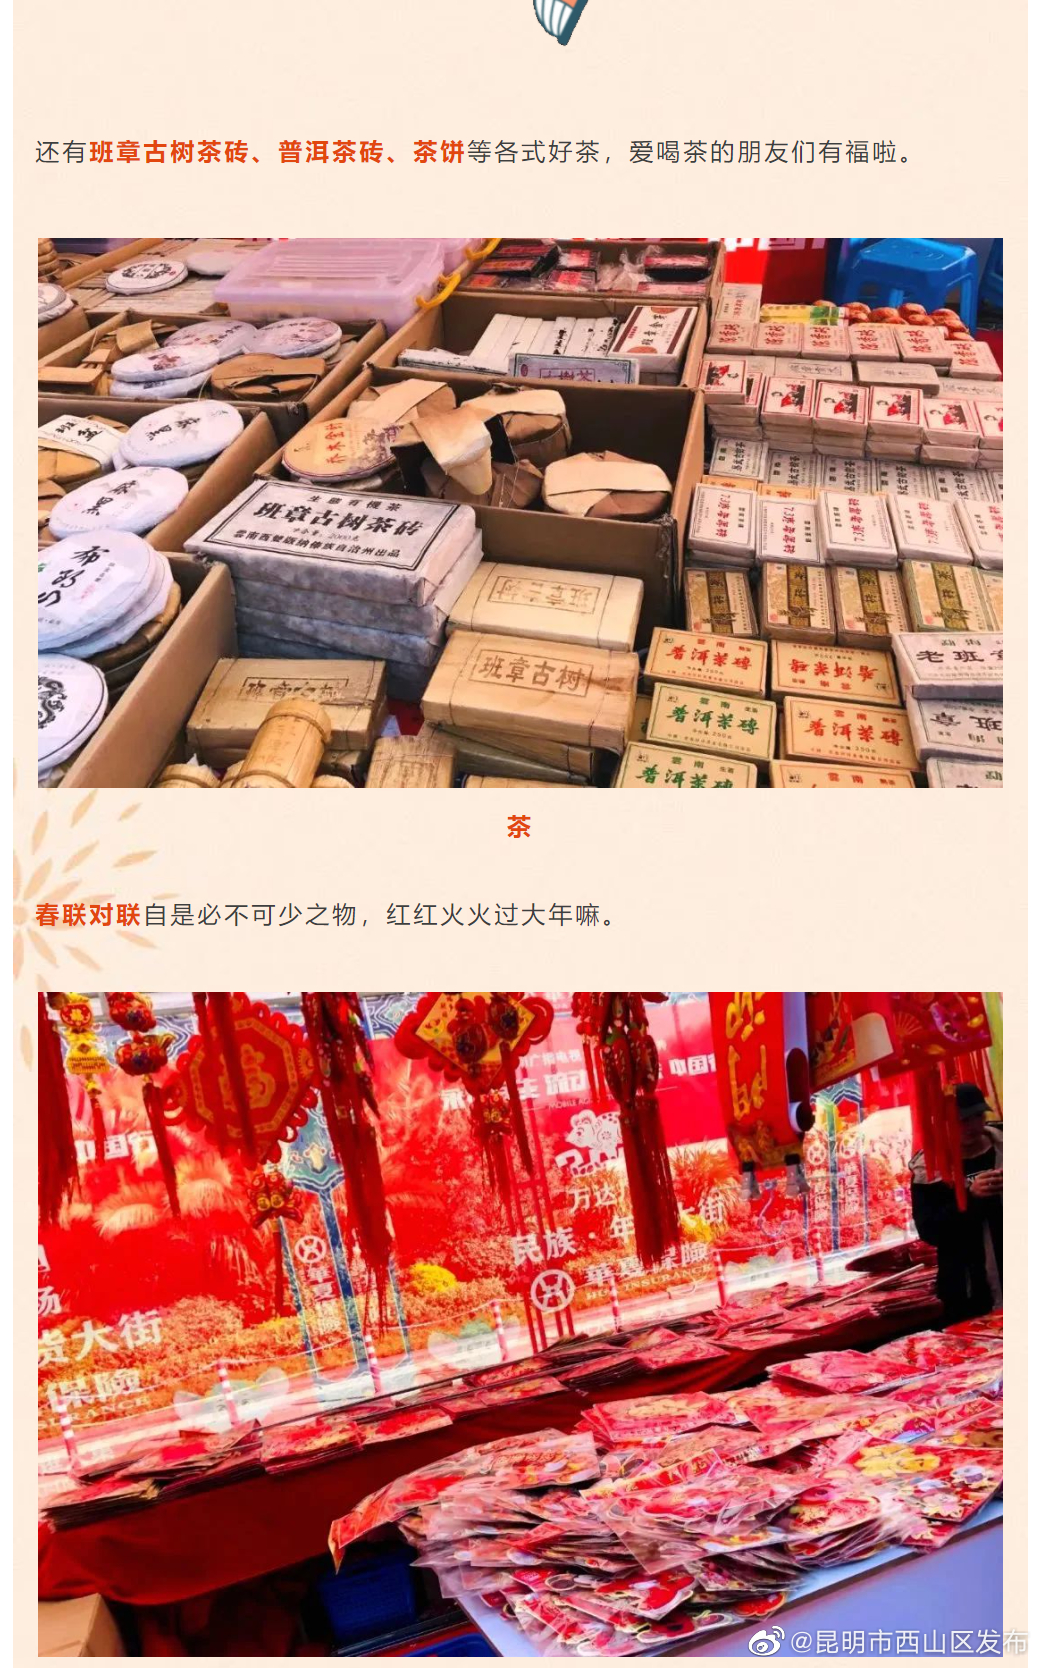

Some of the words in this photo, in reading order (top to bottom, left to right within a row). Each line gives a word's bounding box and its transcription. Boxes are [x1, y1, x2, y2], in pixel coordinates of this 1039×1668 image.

[253, 501, 423, 536] 班章古树茶砖
[307, 495, 402, 512] 生態有機茶
[476, 656, 587, 696] 班章古树
